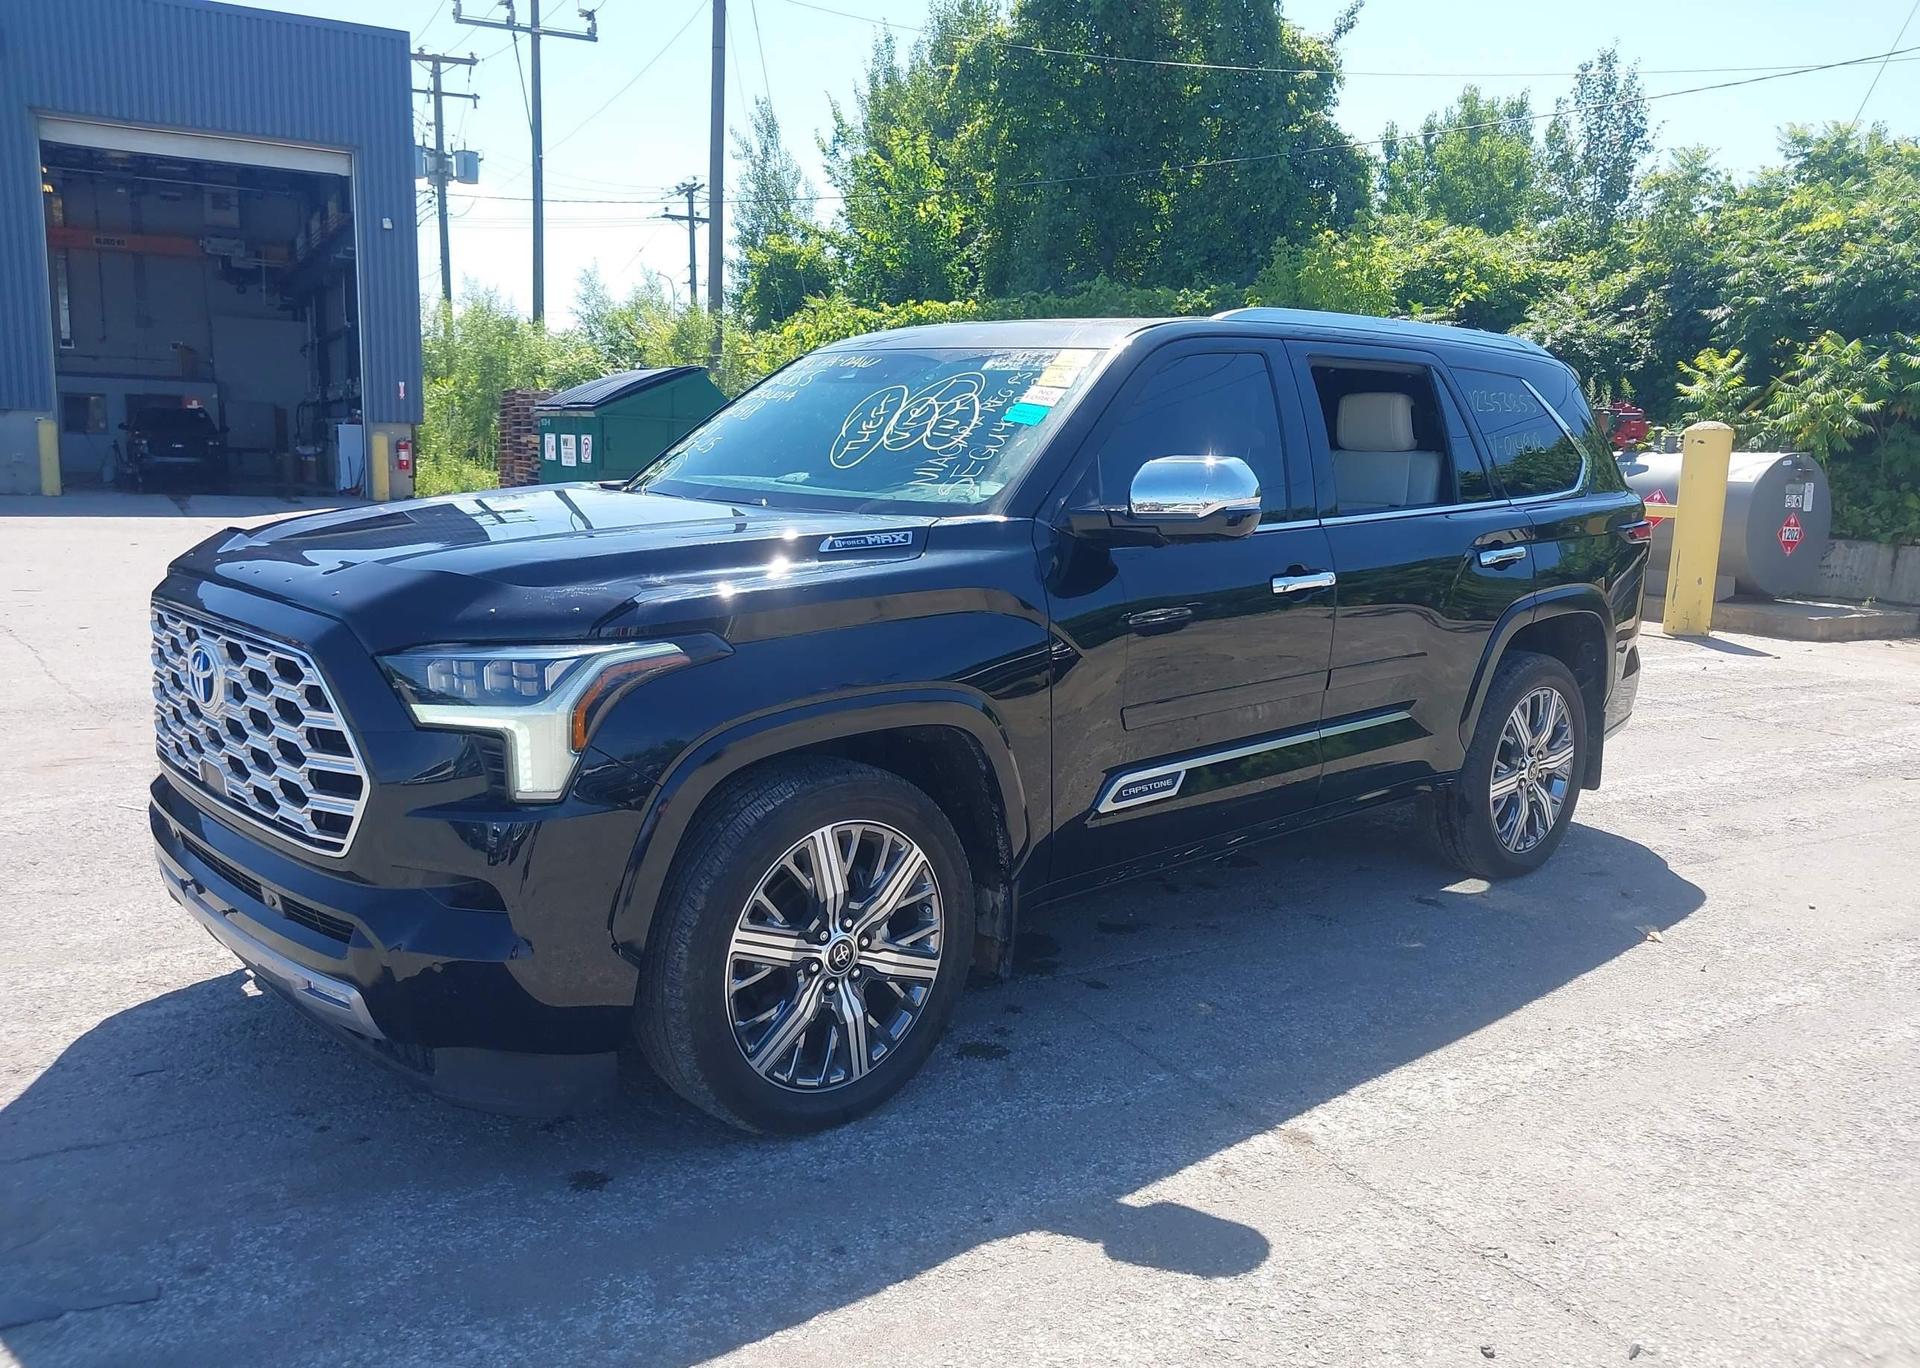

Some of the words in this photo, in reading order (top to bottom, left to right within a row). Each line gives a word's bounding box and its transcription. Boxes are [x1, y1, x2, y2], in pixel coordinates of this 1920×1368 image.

[866, 533, 908, 546] MAX
[1783, 527, 1799, 541] 1202
[1122, 779, 1173, 796] CAPSTONE
